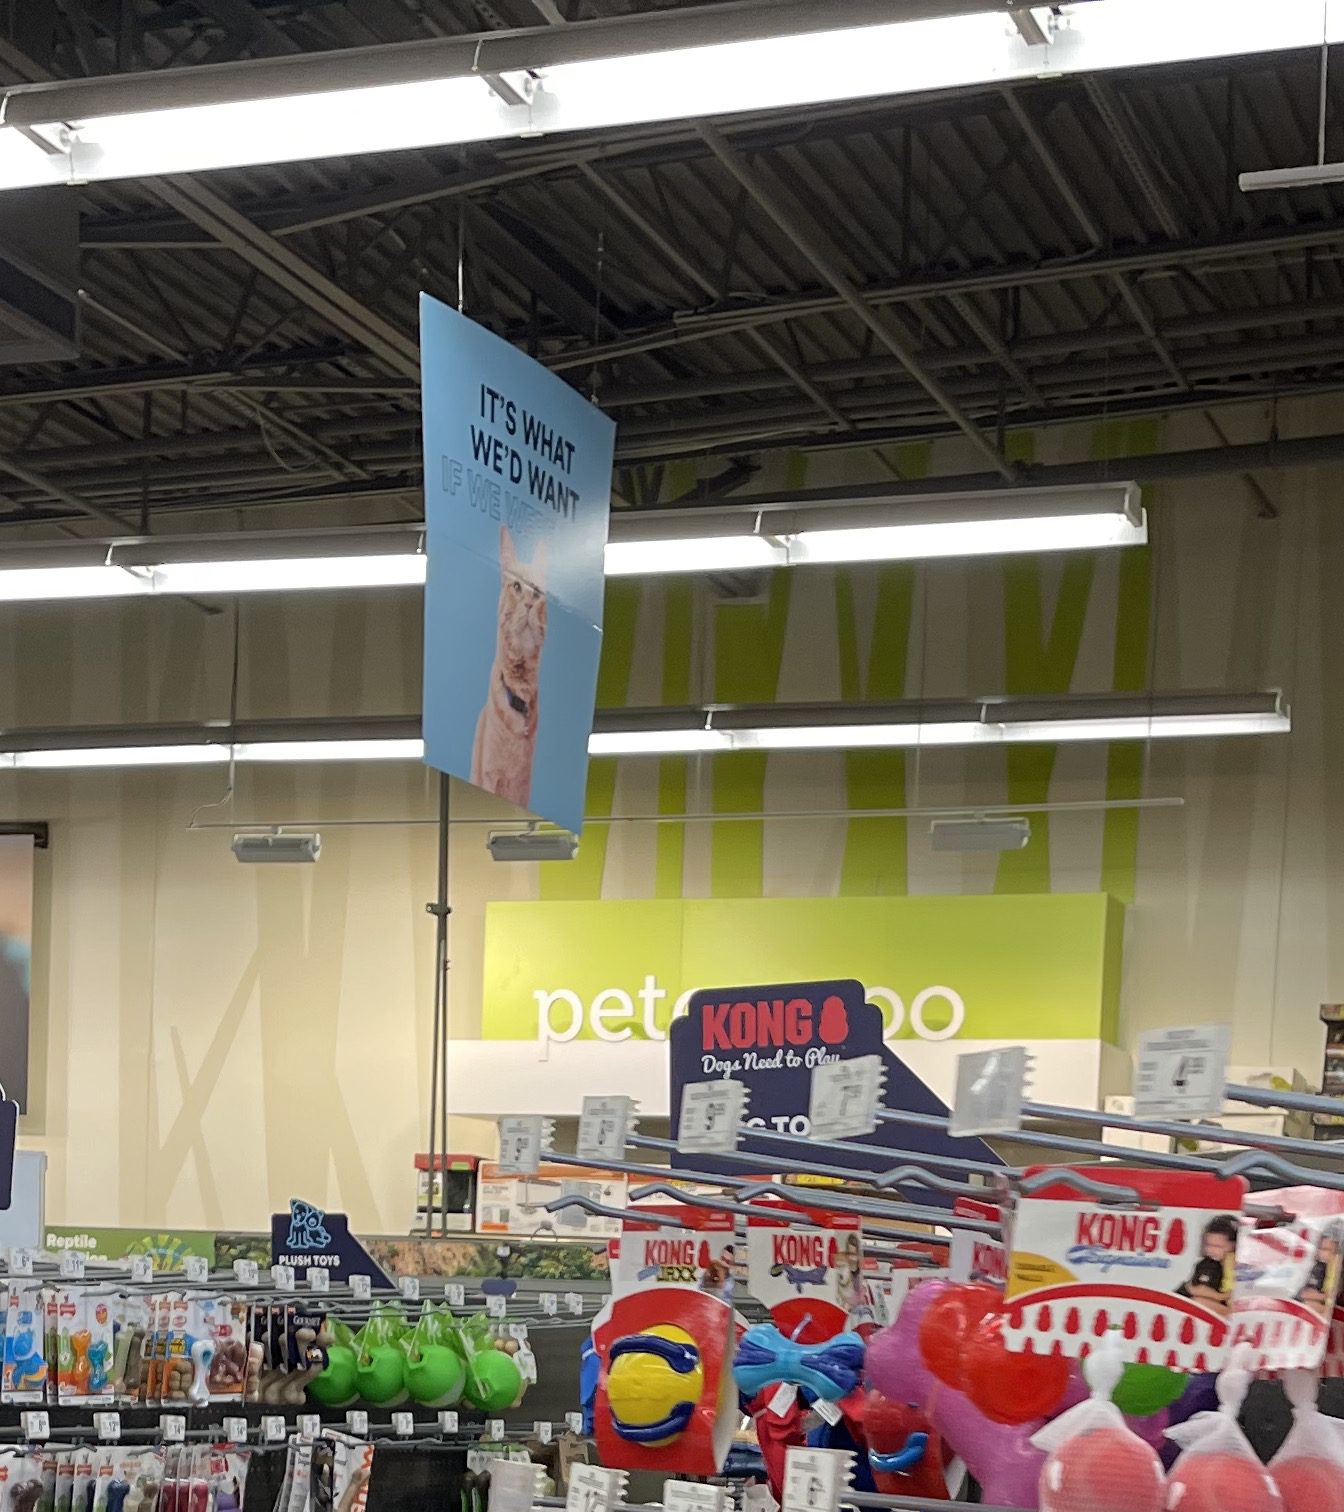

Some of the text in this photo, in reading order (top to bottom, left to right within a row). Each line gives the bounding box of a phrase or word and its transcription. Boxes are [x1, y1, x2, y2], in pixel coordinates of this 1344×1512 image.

[480, 383, 575, 476] IT'S WHAT
[470, 424, 580, 524] WE'D WANT
[702, 998, 812, 1051] KONG
[701, 1053, 742, 1080] Dogs
[743, 1049, 784, 1072] Need
[786, 1048, 803, 1068] to
[46, 1232, 97, 1250] Reptile
[1076, 1212, 1162, 1253] KONG
[278, 1254, 341, 1267] PLUSH TOYS
[644, 1239, 696, 1267] KONG
[772, 1233, 824, 1266] KONG
